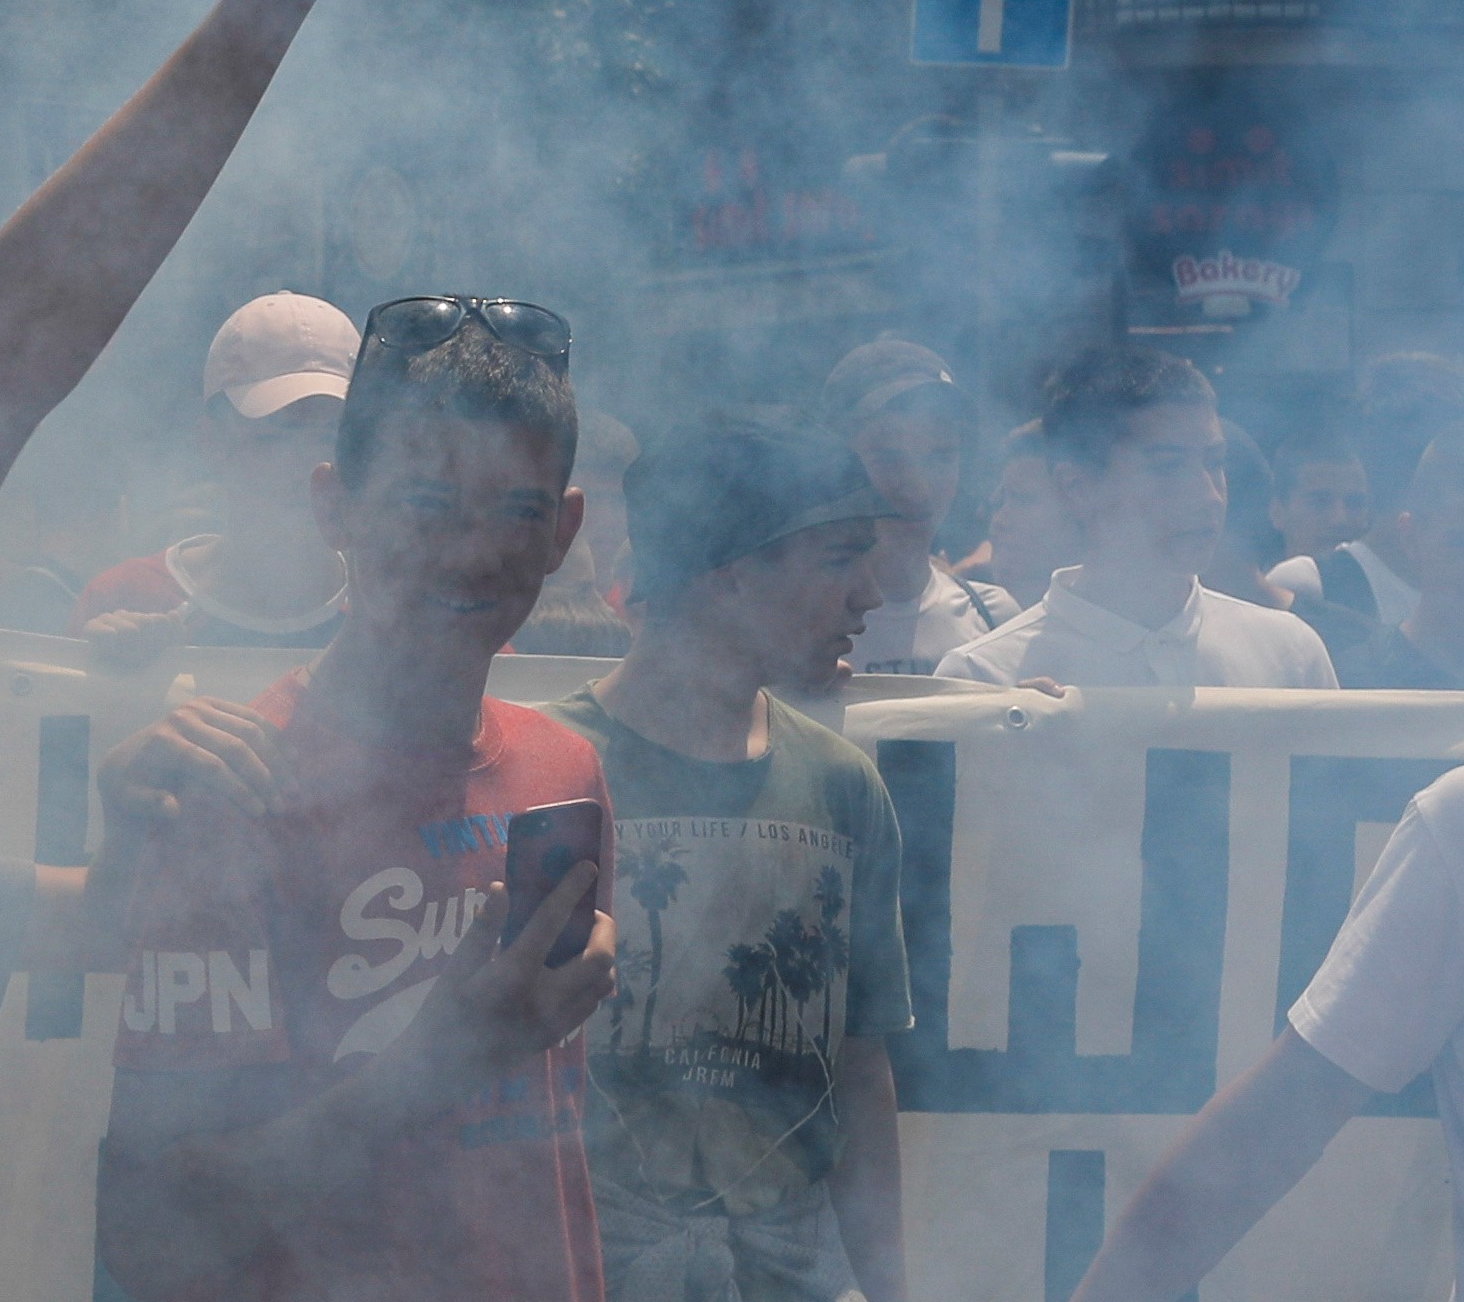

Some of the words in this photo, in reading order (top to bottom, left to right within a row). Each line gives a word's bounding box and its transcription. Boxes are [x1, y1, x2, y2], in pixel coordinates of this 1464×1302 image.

[1175, 250, 1300, 294] Bakery
[634, 821, 682, 839] YOUR
[758, 823, 791, 842] LOS
[123, 948, 274, 1035] JPN
